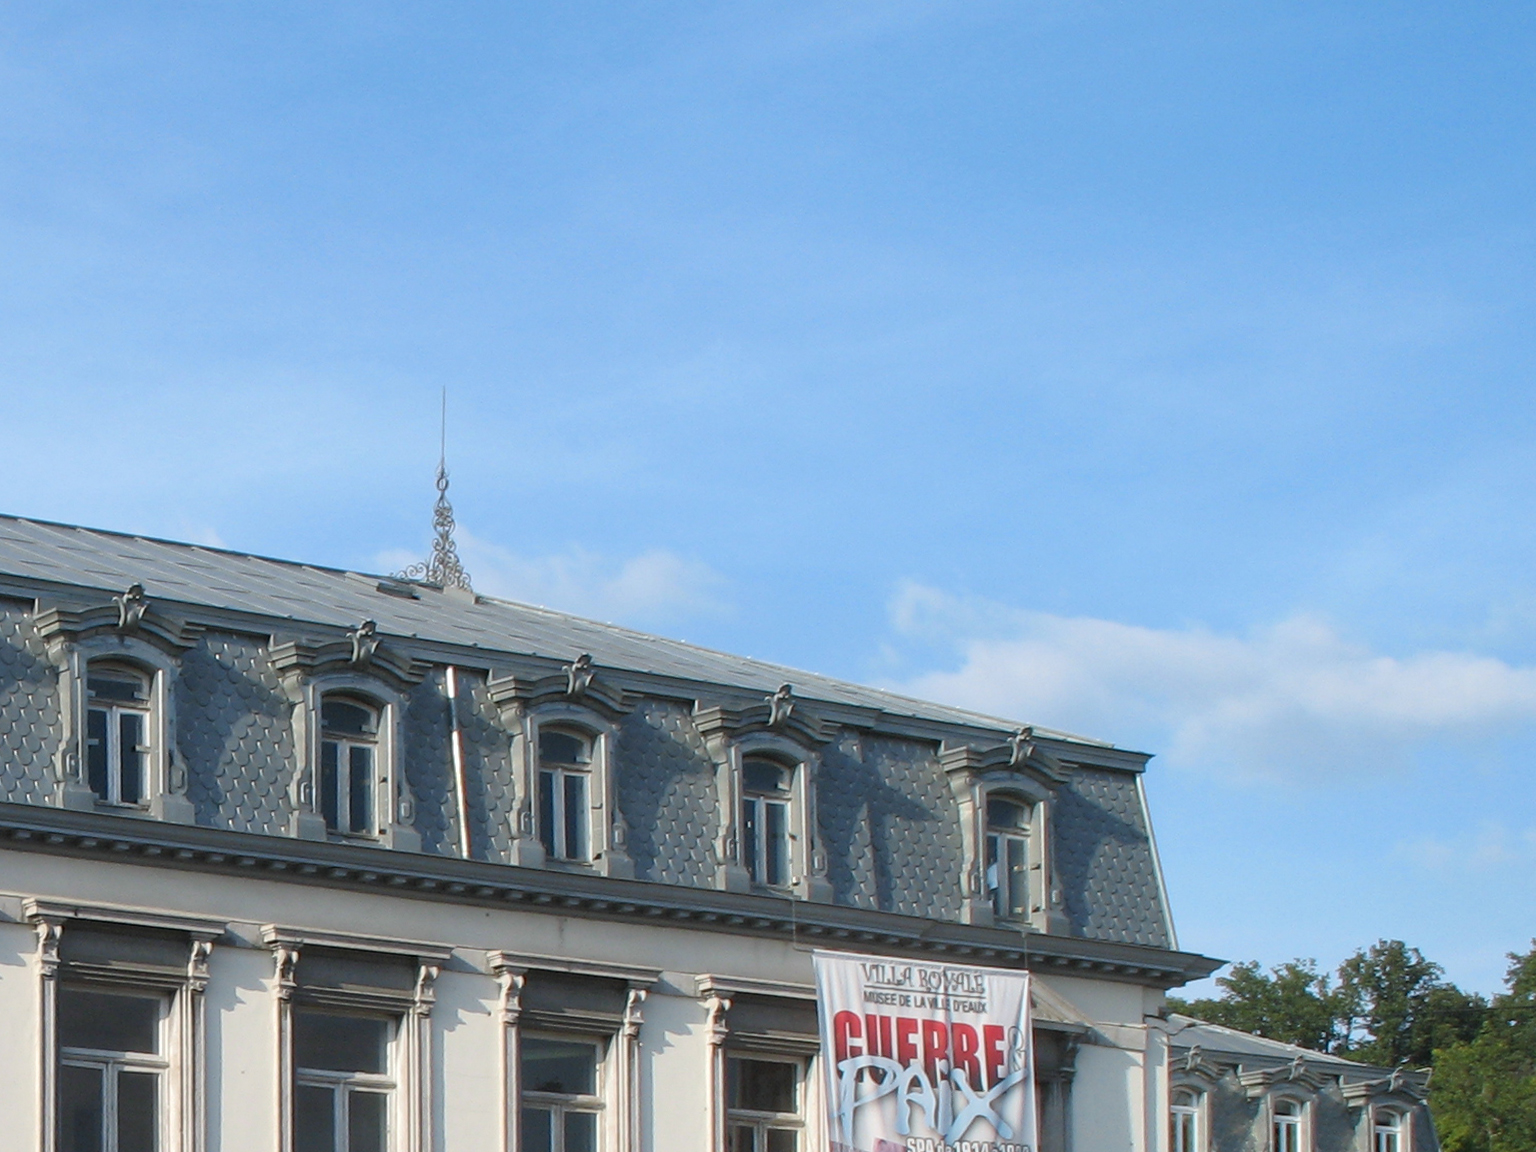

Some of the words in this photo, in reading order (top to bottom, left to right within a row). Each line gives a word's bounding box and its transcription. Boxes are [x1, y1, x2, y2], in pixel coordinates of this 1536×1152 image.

[861, 963, 914, 988] VILLA
[917, 967, 986, 994] ROYALE
[899, 994, 911, 1007] DE
[914, 996, 926, 1008] LA
[833, 1010, 1005, 1092] GUERRE
